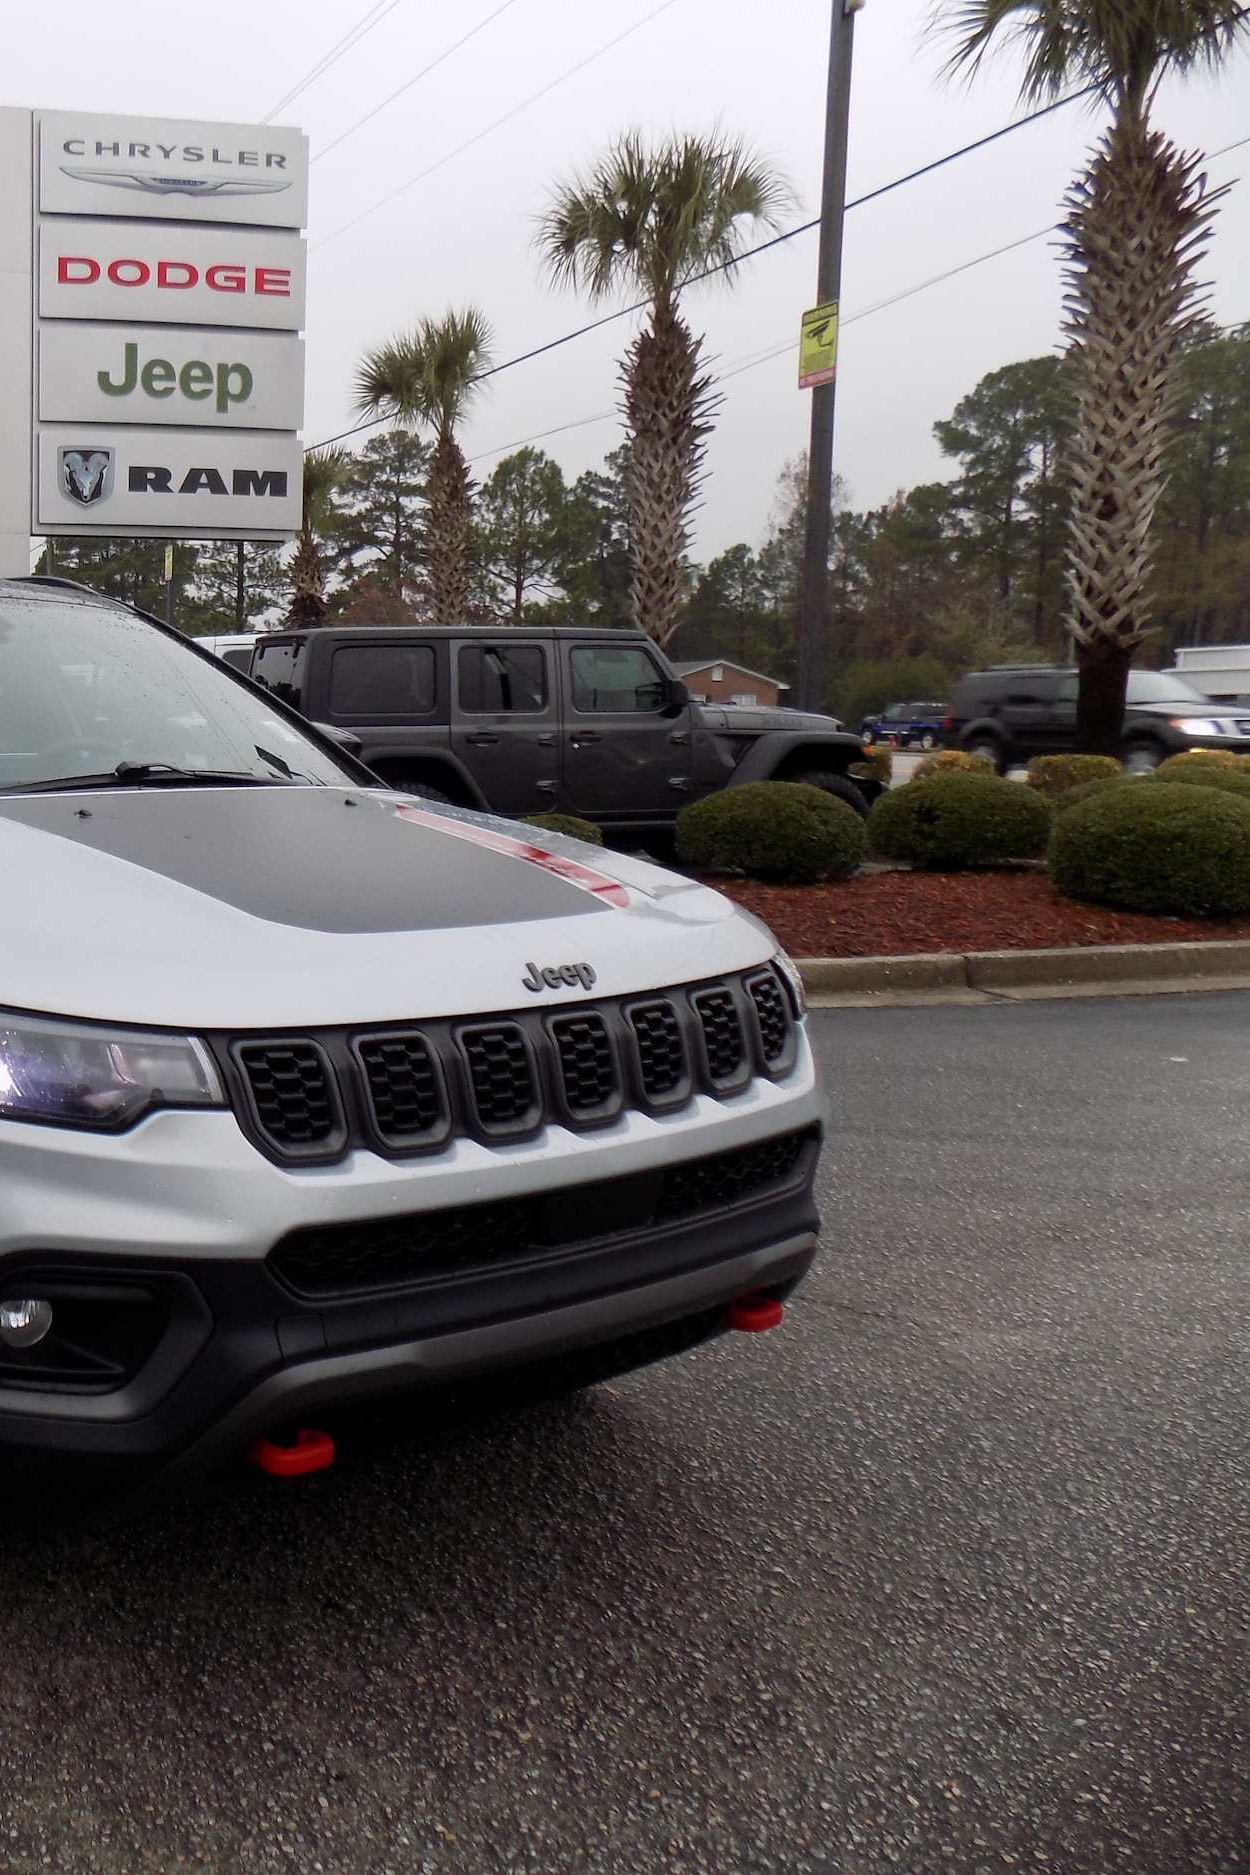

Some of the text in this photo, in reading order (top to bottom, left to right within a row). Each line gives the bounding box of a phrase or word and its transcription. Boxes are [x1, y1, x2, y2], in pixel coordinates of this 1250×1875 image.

[62, 139, 288, 170] CHRYSLER
[57, 256, 291, 298] DODGE
[97, 342, 253, 413] Jeep
[128, 465, 288, 498] RAM
[522, 962, 597, 993] Jeep
